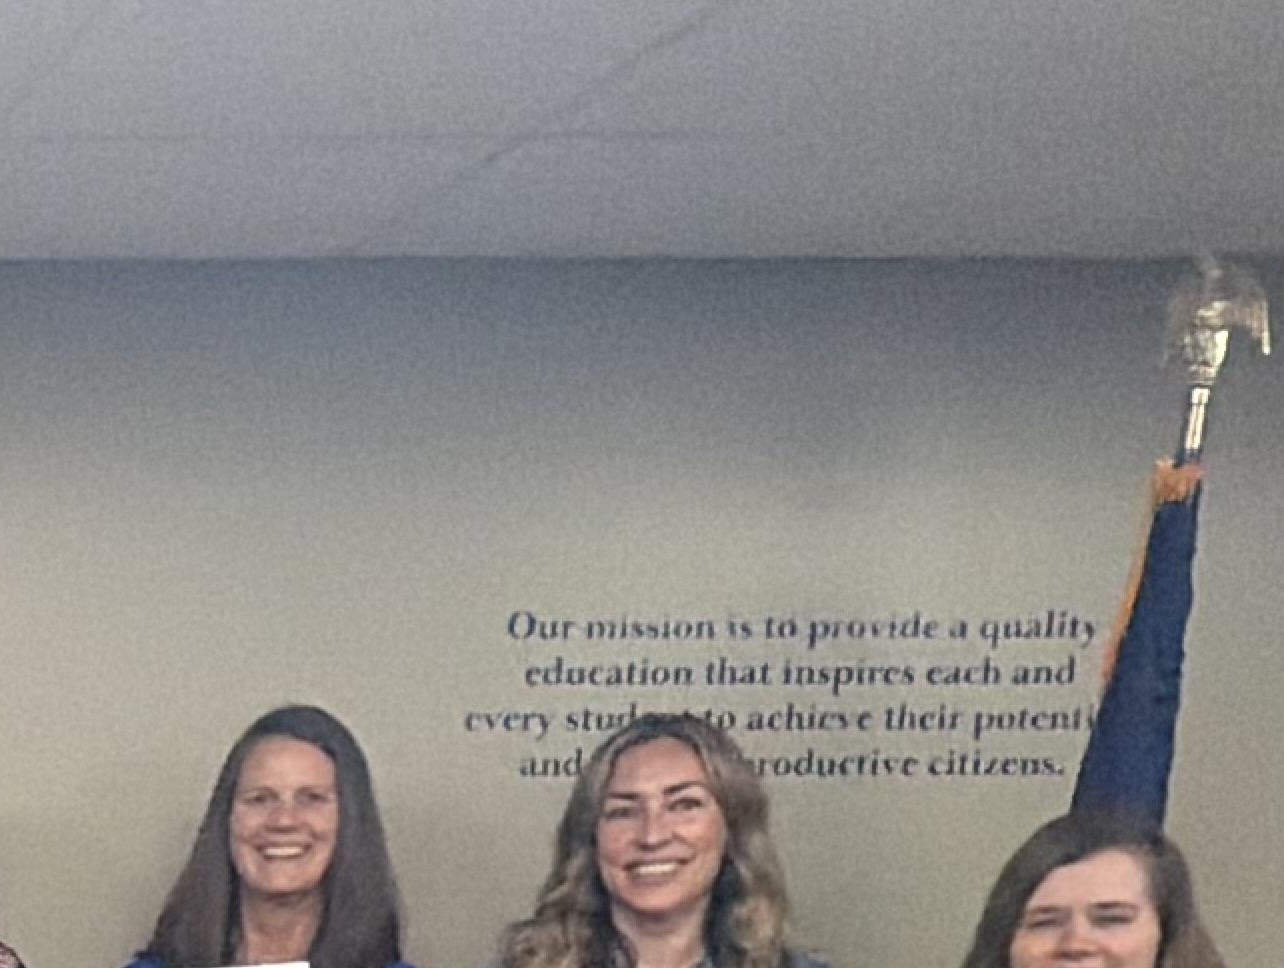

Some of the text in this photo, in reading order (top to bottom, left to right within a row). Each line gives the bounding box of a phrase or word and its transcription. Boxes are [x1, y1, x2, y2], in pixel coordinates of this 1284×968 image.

[507, 609, 1096, 650] Our mission is to provide a quality
[525, 655, 1075, 697] education that inspires each and
[464, 711, 552, 742] every
[747, 703, 873, 732] achieve
[885, 703, 961, 732] their
[519, 748, 1064, 777] and roductive citizens.
